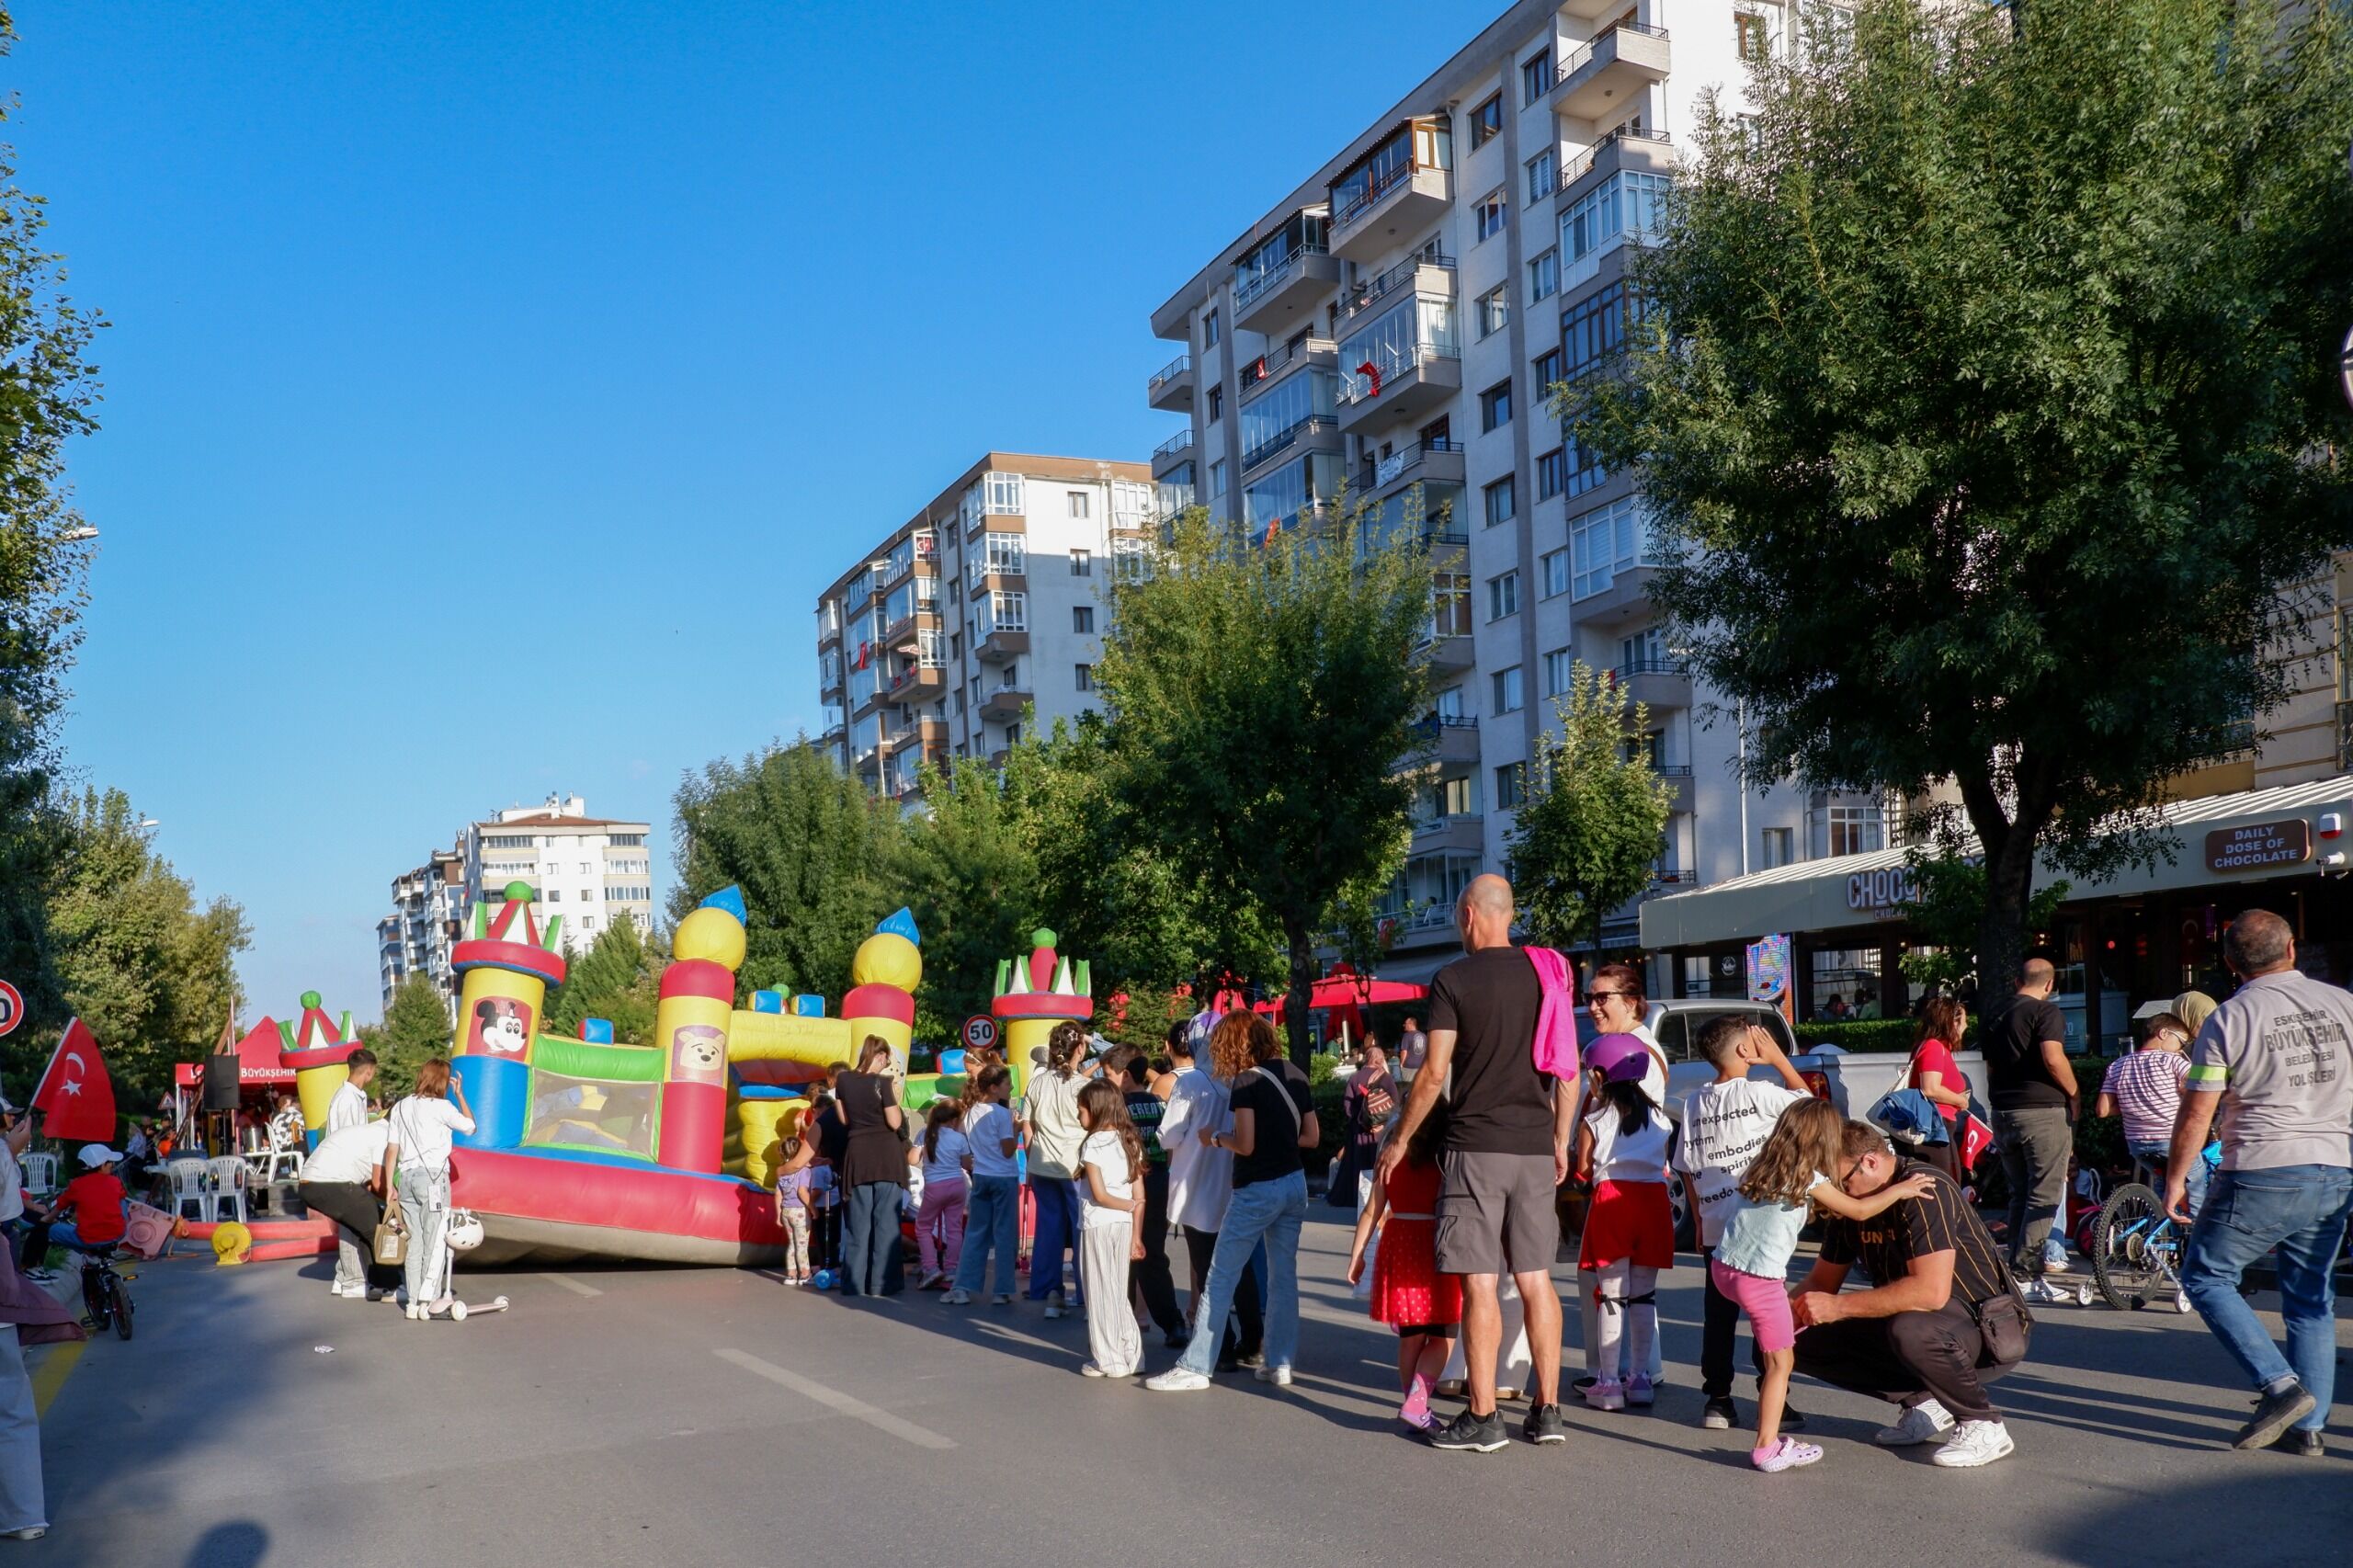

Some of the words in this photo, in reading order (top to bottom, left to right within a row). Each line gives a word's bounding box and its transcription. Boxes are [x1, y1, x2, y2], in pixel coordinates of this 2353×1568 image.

[2234, 826, 2275, 841] DAILY
[2225, 840, 2262, 854] DOSE
[2267, 837, 2285, 849] OF
[2214, 849, 2297, 868] CHOCOLATE
[970, 1023, 993, 1040] 50
[2288, 1074, 2307, 1086] YOL
[1708, 1134, 1767, 1160] embodies
[1699, 1187, 1738, 1205] reedo
